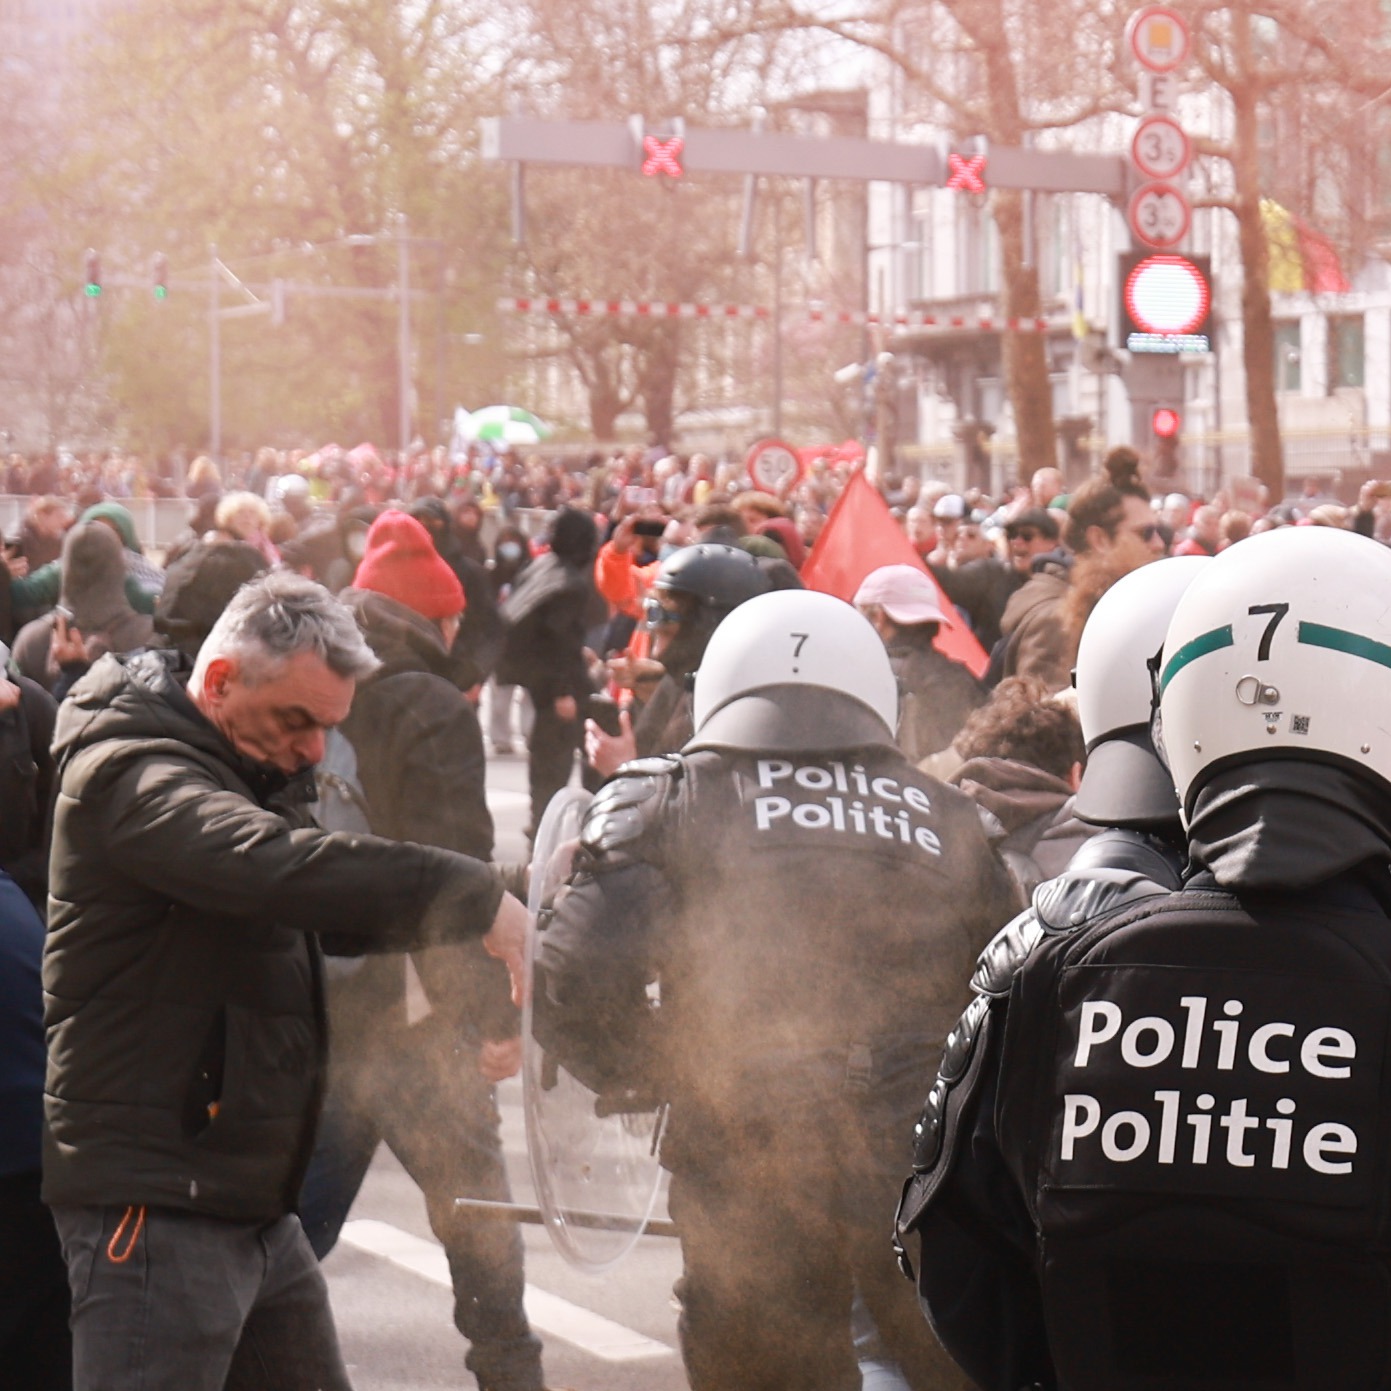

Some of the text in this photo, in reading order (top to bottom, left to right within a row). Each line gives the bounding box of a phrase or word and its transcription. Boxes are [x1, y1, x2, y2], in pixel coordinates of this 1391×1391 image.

[789, 633, 809, 657] 7
[1248, 603, 1290, 661] 7
[758, 758, 930, 815] Police
[755, 794, 942, 856] Politie
[1074, 996, 1357, 1079] Police
[1060, 1090, 1358, 1175] Politie
